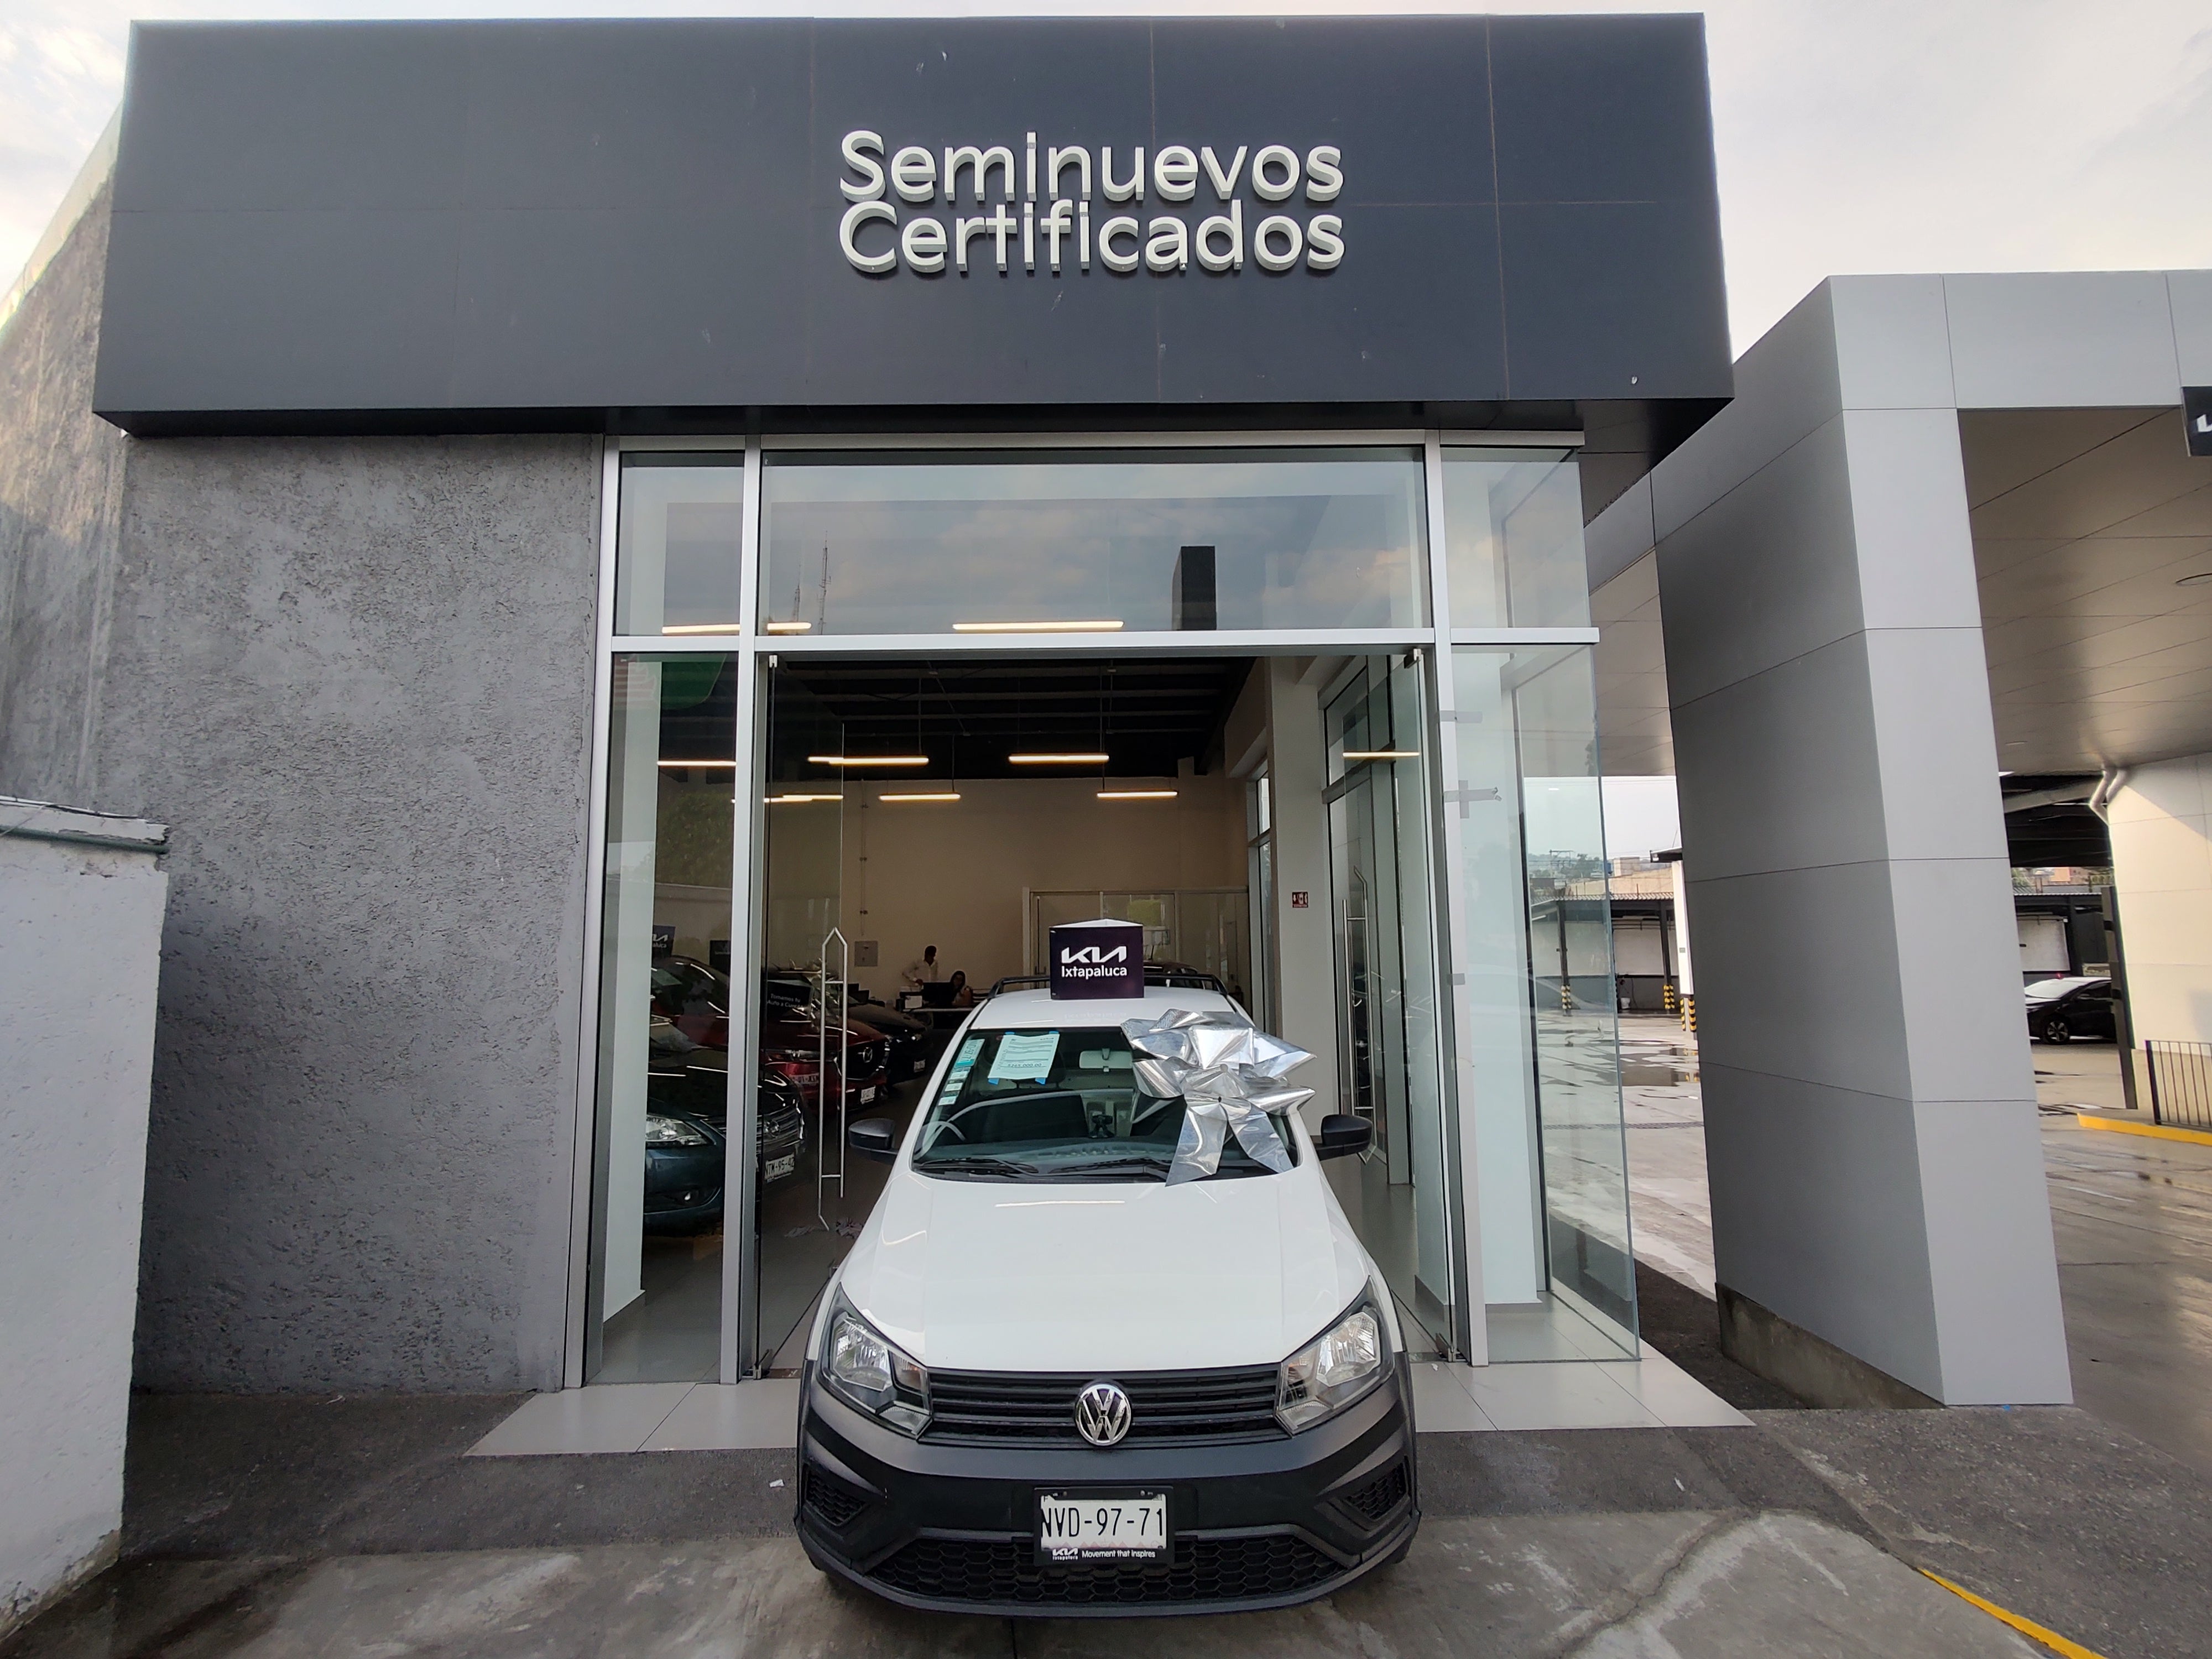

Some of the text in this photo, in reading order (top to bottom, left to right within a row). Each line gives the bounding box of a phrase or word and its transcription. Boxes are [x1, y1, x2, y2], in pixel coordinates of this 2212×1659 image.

[839, 129, 1344, 202] Seminuevos
[839, 199, 1345, 273] Certificados
[1061, 946, 1127, 964] KIA
[1061, 965, 1127, 979] Ixtapaluca
[1041, 1507, 1163, 1537] NVD-97-71
[1131, 1550, 1156, 1558] inspires
